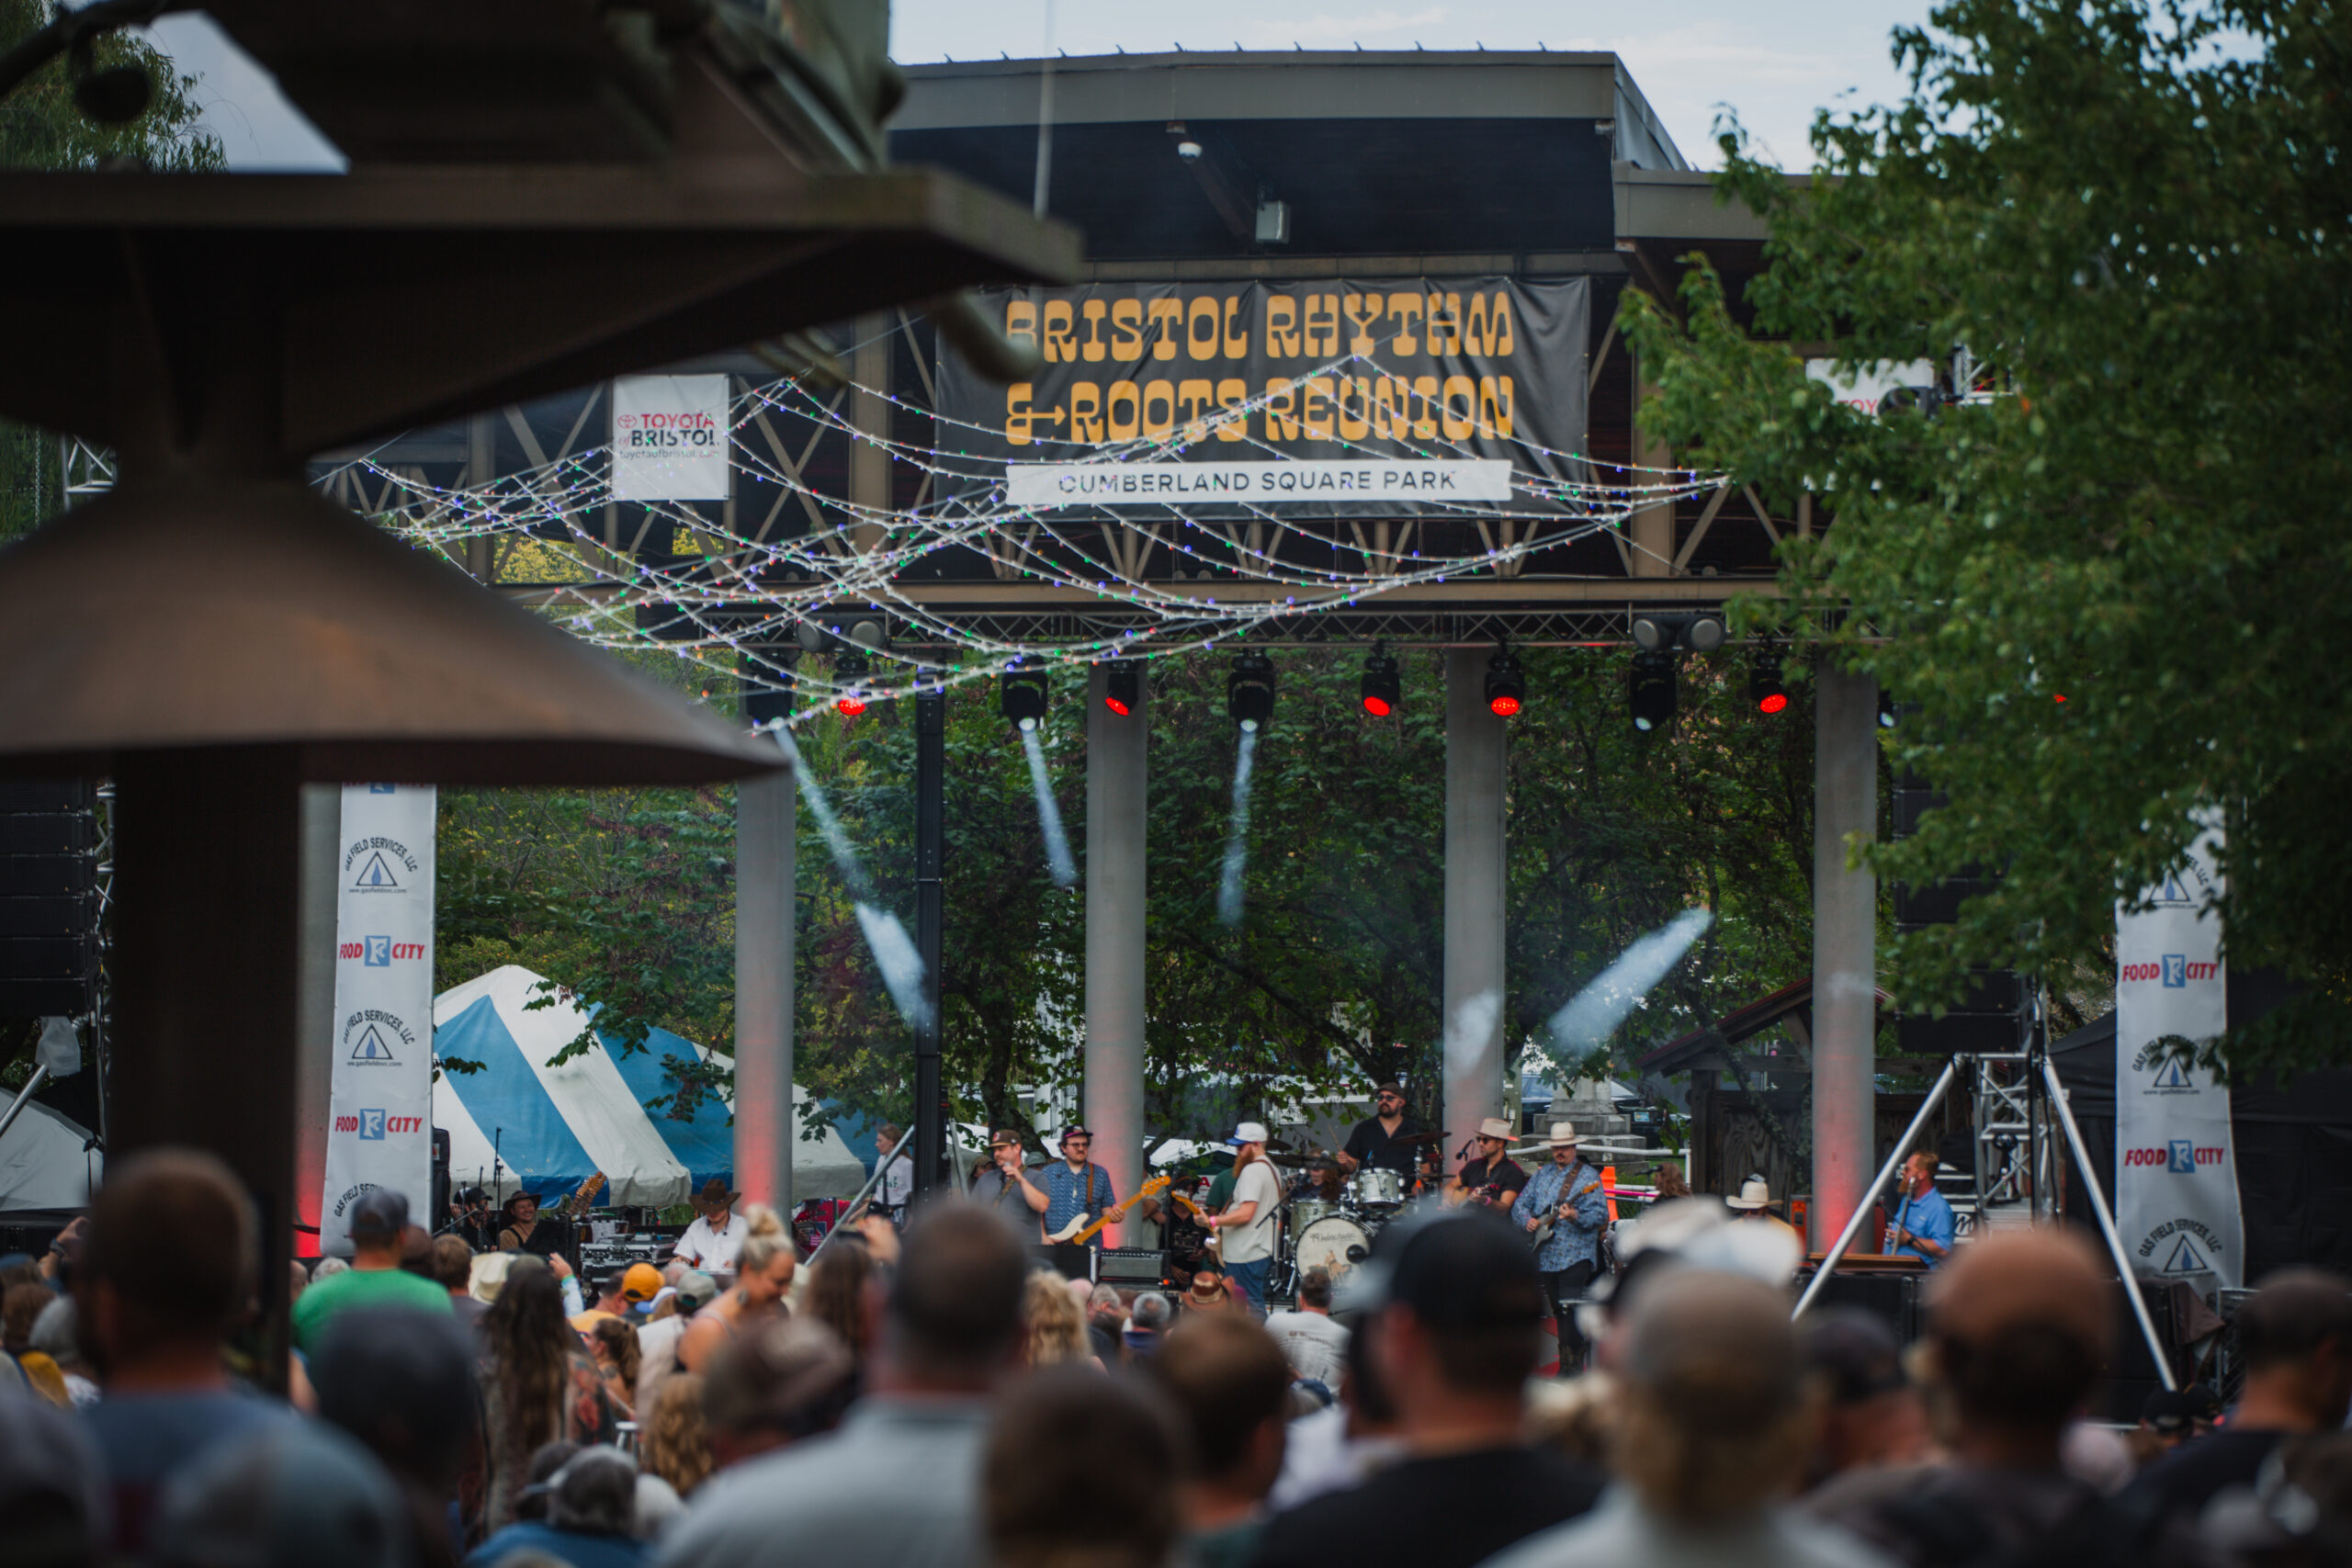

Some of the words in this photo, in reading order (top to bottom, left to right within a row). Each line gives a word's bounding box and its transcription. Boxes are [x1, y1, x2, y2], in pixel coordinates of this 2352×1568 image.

[1006, 295, 1248, 363] BRISTOL
[1266, 292, 1513, 359] RHYTHM
[640, 412, 715, 429] TOYOTA
[1070, 378, 1247, 445] ROOTS
[1265, 375, 1514, 442] REUNION
[617, 433, 631, 448] of
[631, 429, 719, 446] BRISTOL
[1058, 470, 1250, 493] CUMBERLAND
[1261, 469, 1373, 492] SQUARE
[1383, 469, 1458, 491] PARK
[350, 839, 369, 859] FIELD
[369, 836, 408, 861] SERVICES,
[403, 855, 418, 873] LLC
[339, 942, 363, 960] FOOD
[391, 942, 425, 960] CITY
[2122, 963, 2160, 982] FOOD
[2186, 962, 2218, 980] CITY
[347, 1011, 363, 1031] FIELD
[364, 1009, 403, 1033] SERVICES,
[400, 1027, 415, 1044] LLC
[2132, 1052, 2147, 1072] GAS
[335, 1115, 359, 1133] FOOD
[387, 1115, 423, 1133] CITY
[2124, 1147, 2166, 1167] FOOD
[2194, 1147, 2224, 1166] CITY
[334, 1200, 345, 1218] GAS
[342, 1185, 359, 1204] FIELD
[2139, 1237, 2155, 1258] GAS
[2150, 1221, 2176, 1243] FIELD
[2205, 1235, 2222, 1253] LLC
